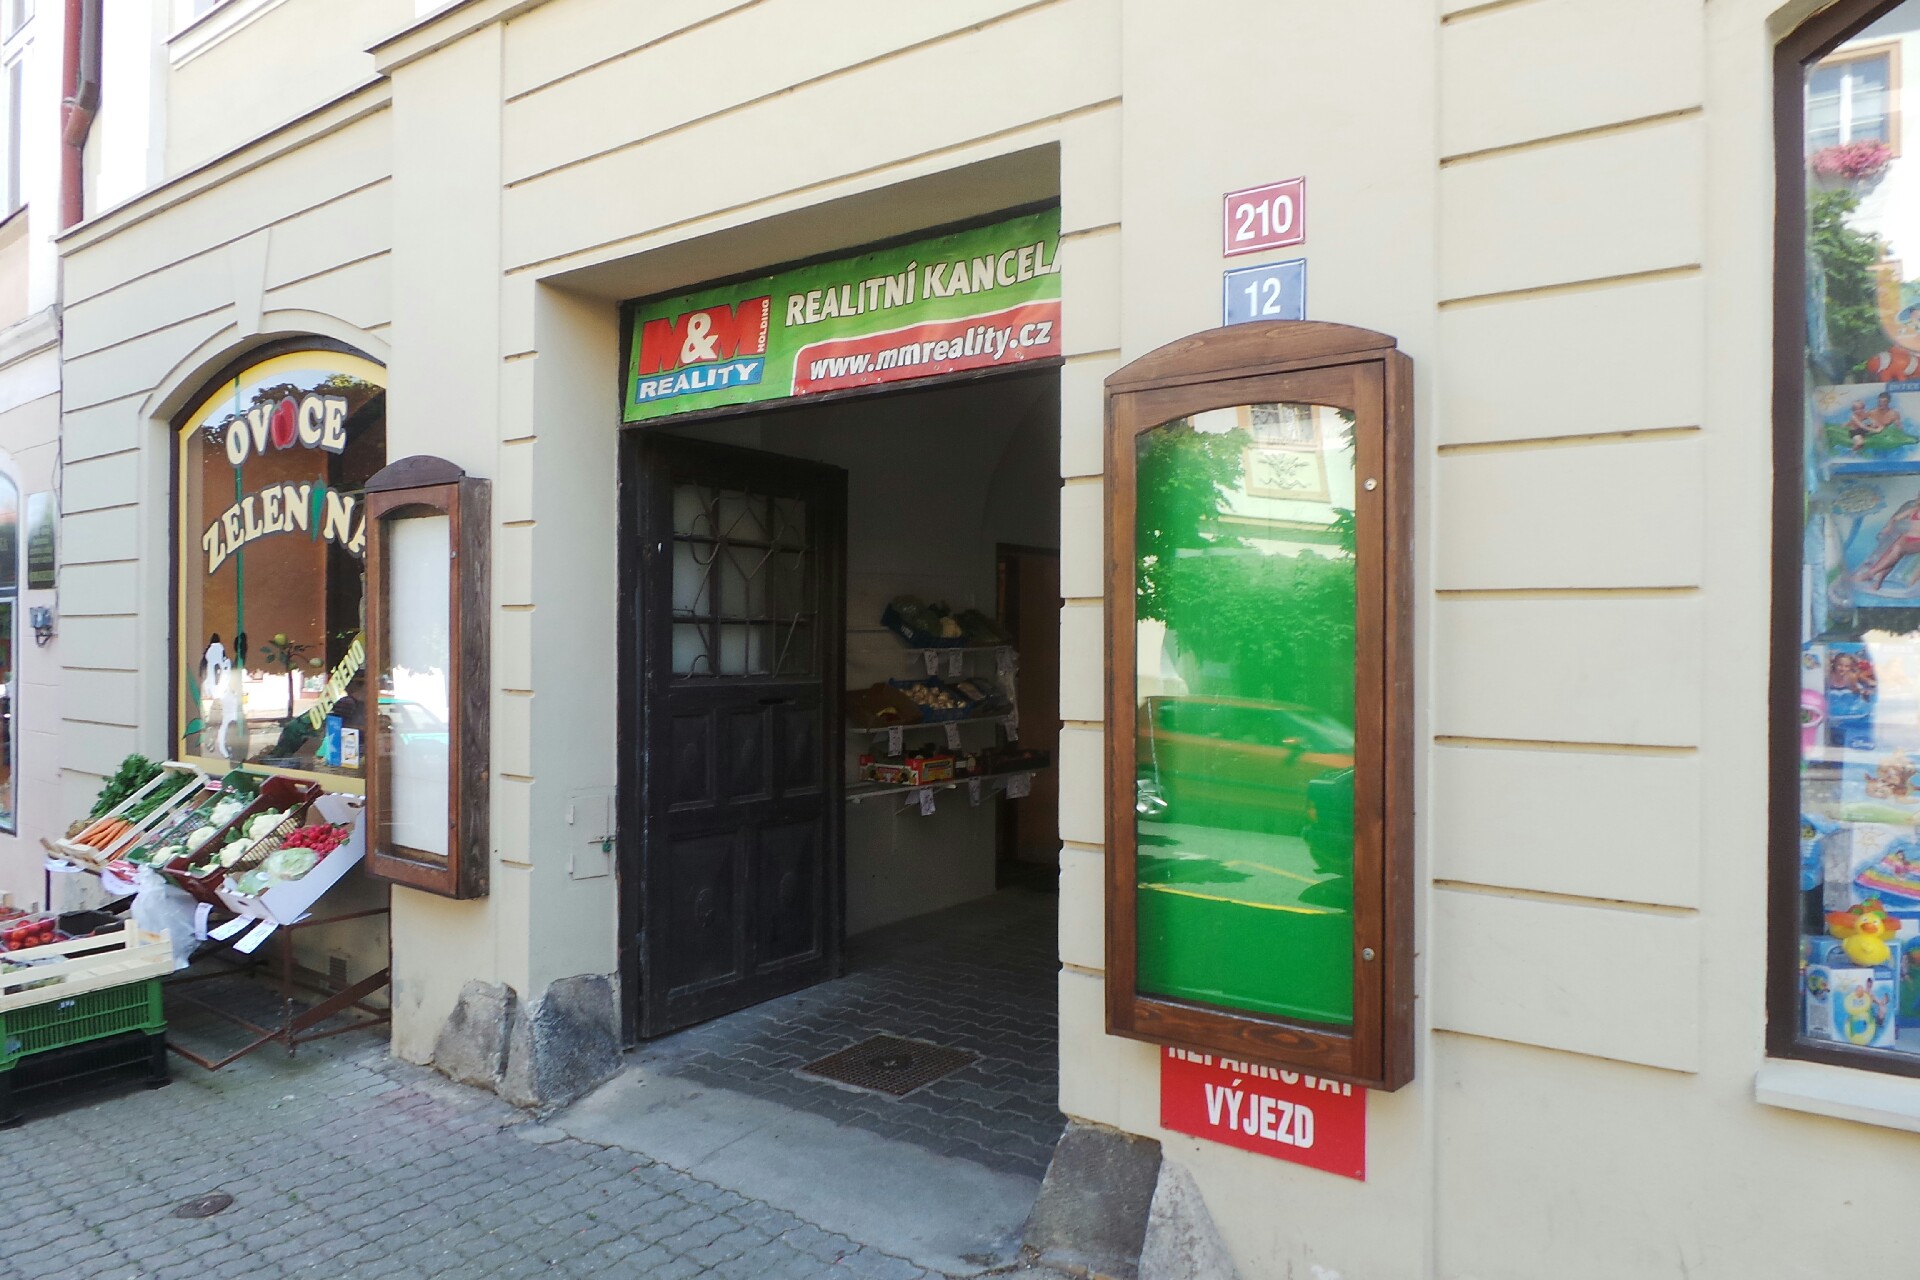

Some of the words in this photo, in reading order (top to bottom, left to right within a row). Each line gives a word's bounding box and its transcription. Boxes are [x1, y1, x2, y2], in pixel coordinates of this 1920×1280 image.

[1235, 194, 1294, 242] 210
[785, 260, 919, 327] REALITNÍ
[1244, 277, 1282, 317] 12
[638, 296, 767, 376] M&M
[757, 299, 770, 353] HOLDING
[809, 320, 1054, 382] www.mmreality.cz
[639, 362, 758, 399] REALITY
[226, 395, 348, 467] OVOCE
[1204, 1079, 1314, 1149] VÝJEZD
